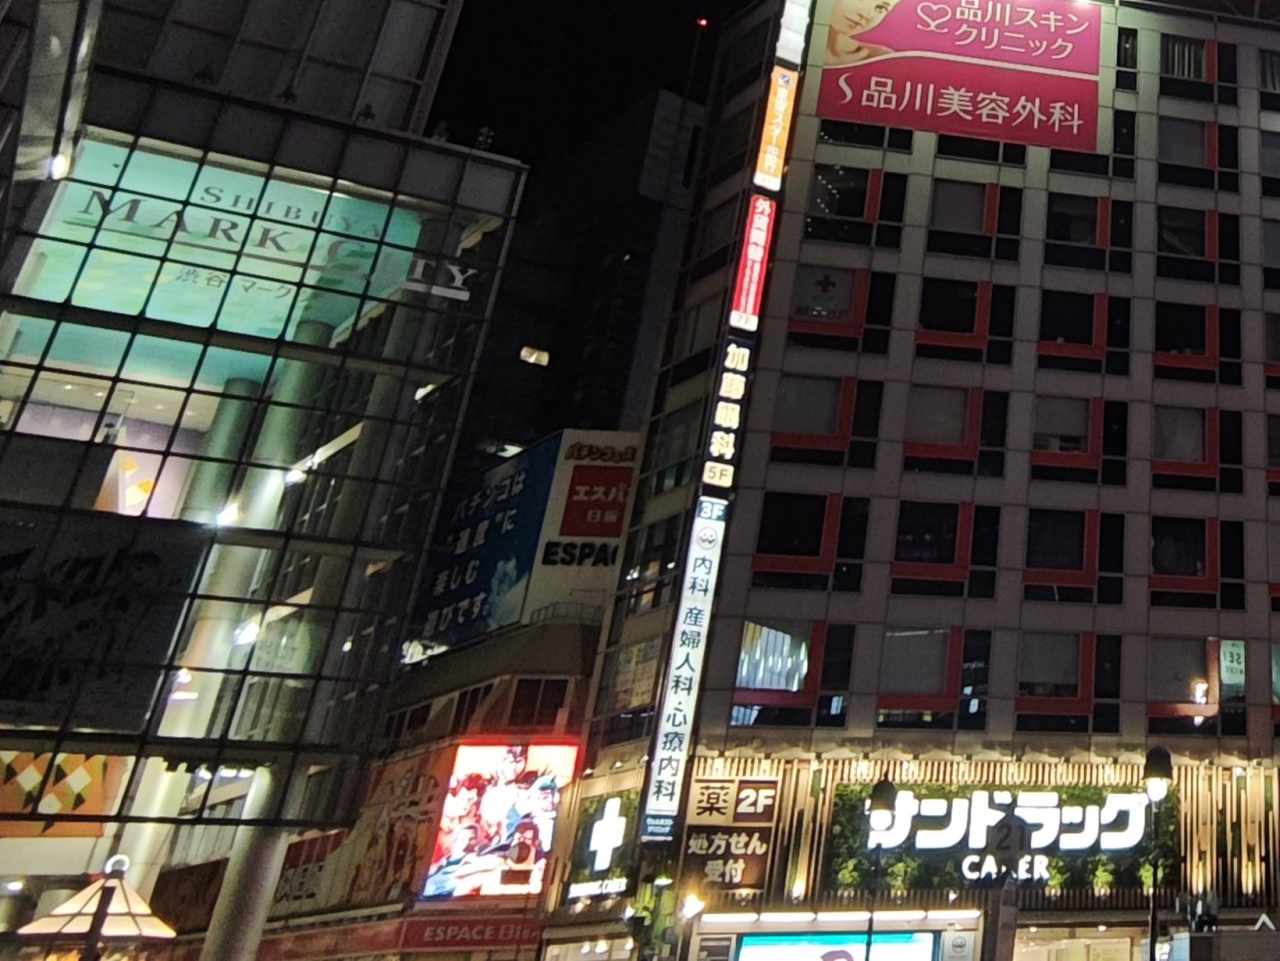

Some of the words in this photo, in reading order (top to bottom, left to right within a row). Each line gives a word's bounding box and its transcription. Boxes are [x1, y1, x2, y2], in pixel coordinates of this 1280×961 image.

[954, 23, 1073, 59] クリニック
[861, 76, 1084, 135] 品川美容外科
[80, 190, 293, 254] MARK
[200, 185, 382, 239] SHIBUYA
[707, 465, 730, 483] 5F
[700, 501, 726, 521] 3F
[688, 556, 713, 597] 内科
[696, 785, 730, 817] 薬
[736, 788, 776, 814] 2F
[864, 790, 1149, 850] サンドラッグ
[688, 832, 768, 855] 処方せん
[704, 858, 746, 884] 受付
[422, 925, 496, 944] ESPACE
